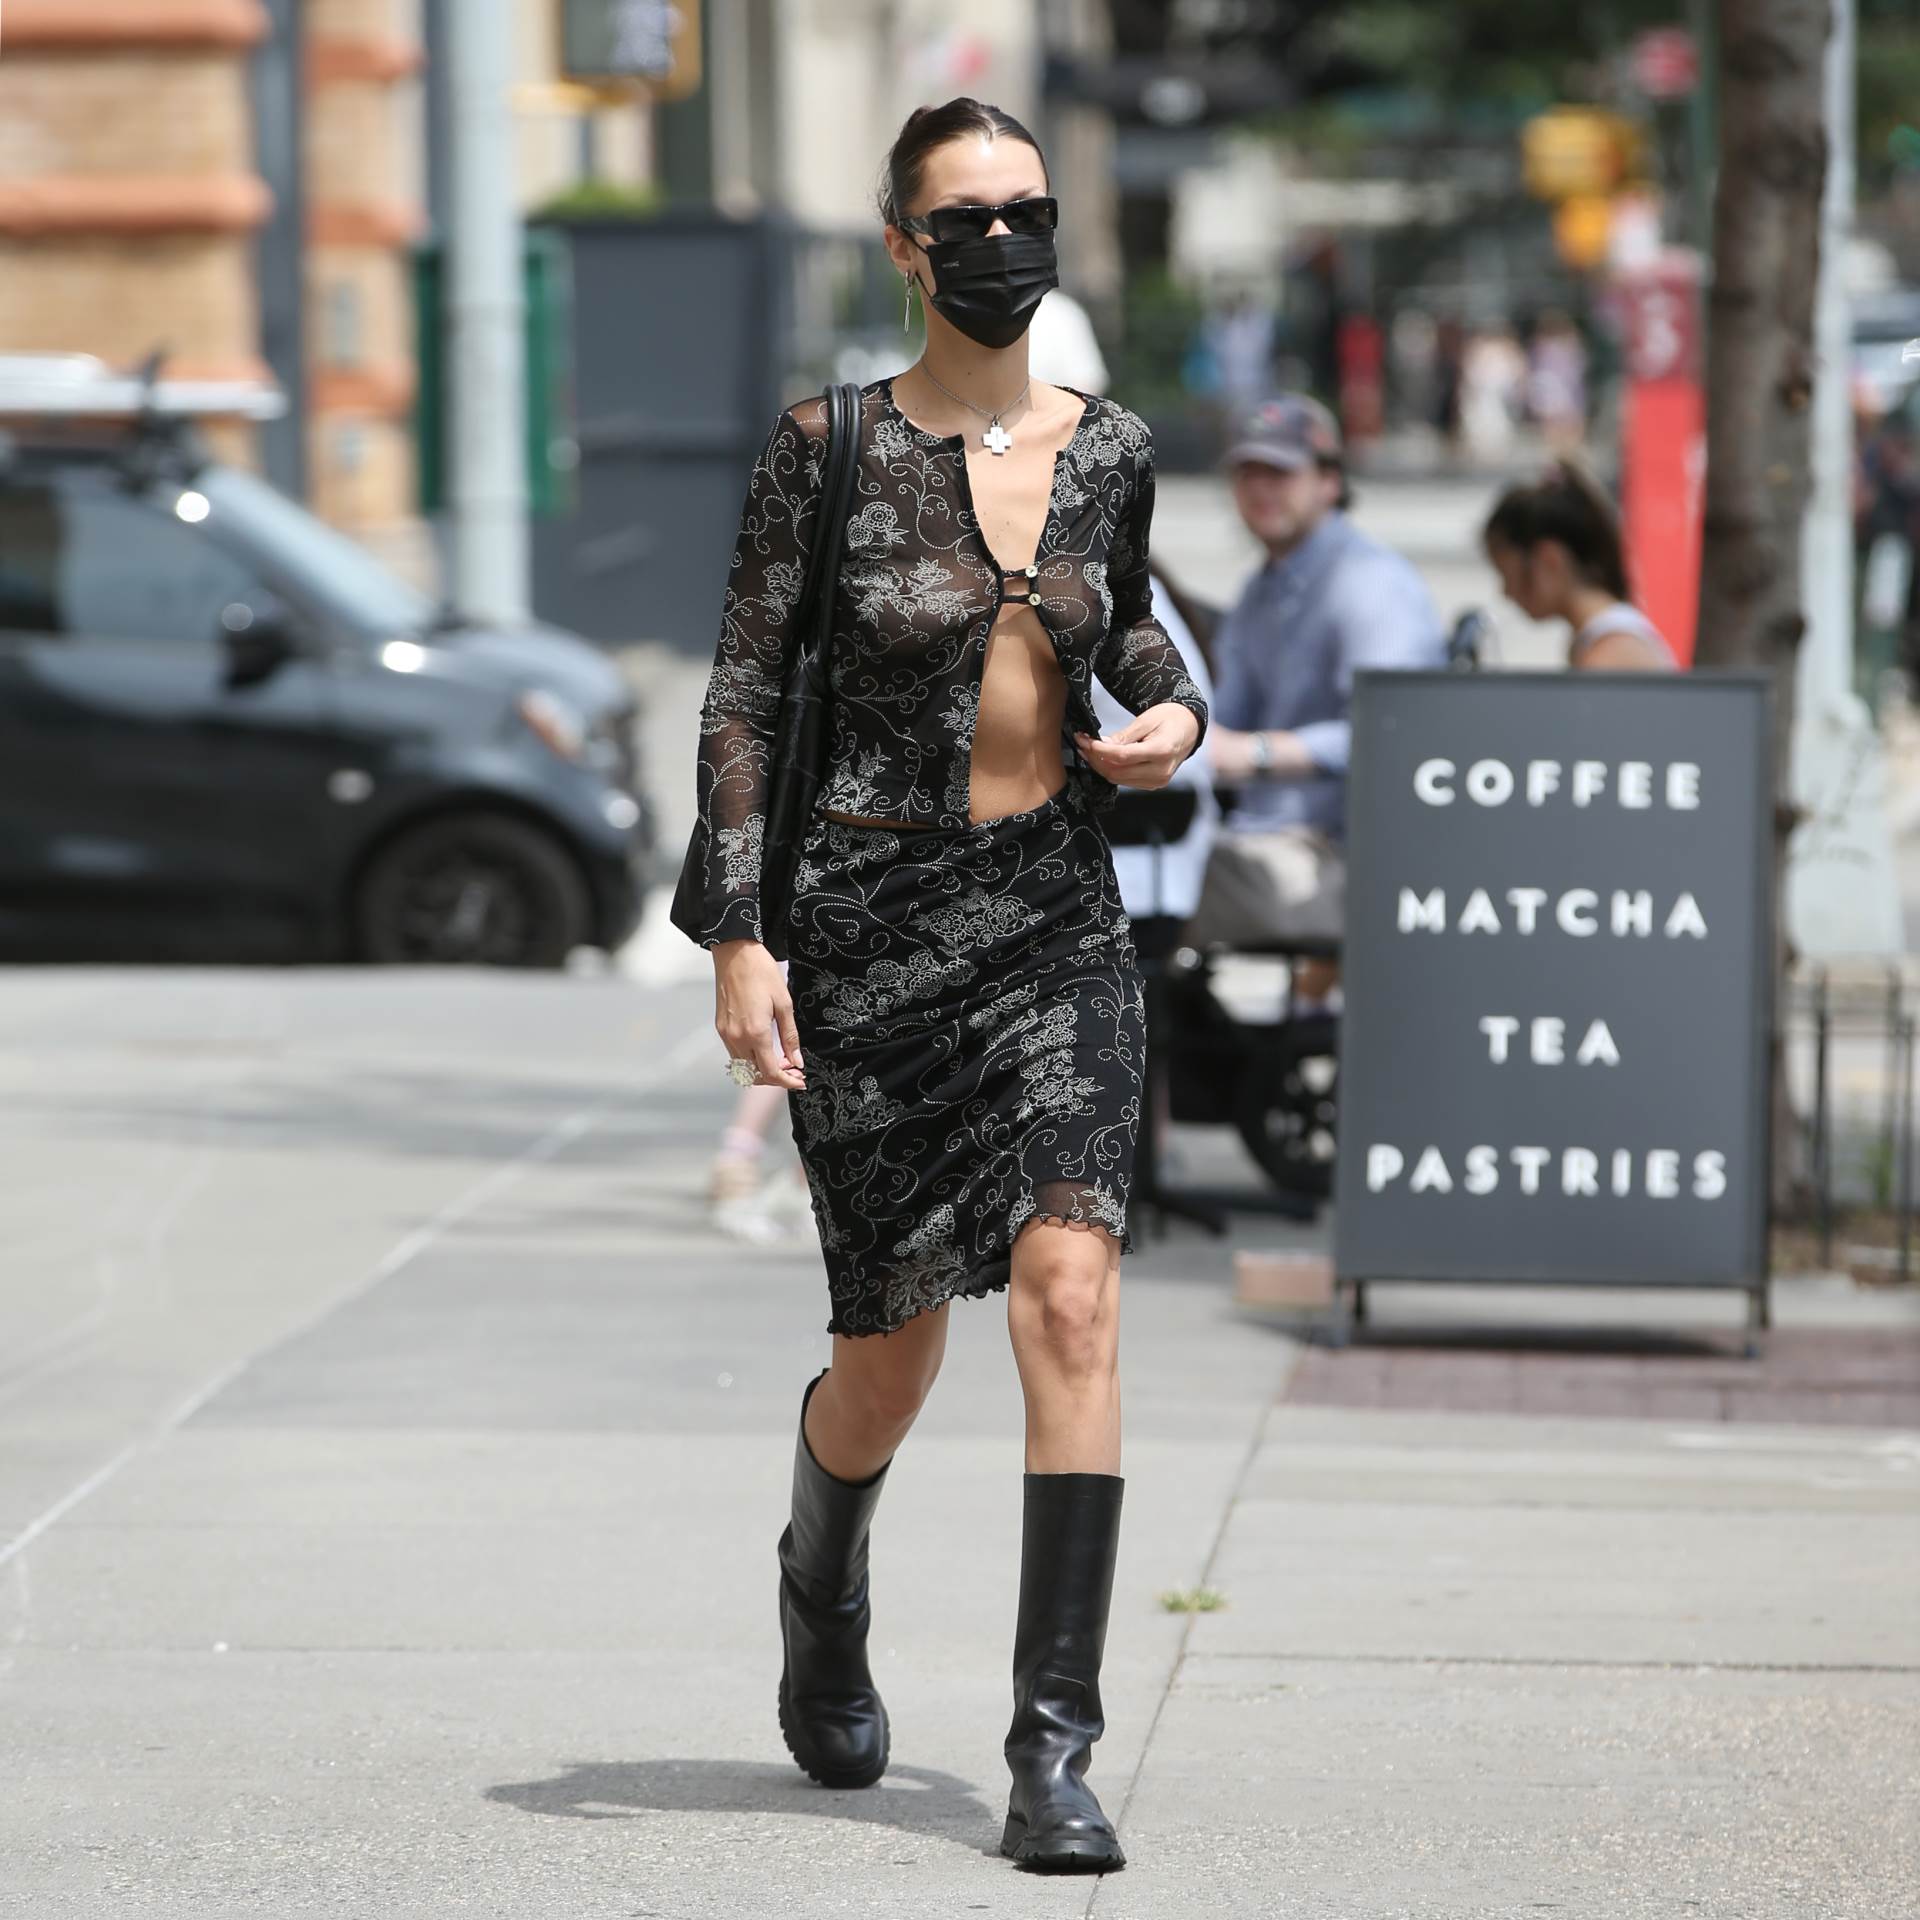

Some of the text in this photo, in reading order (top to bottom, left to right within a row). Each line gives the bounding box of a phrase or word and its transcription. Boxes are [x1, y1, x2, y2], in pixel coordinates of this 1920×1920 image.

[1413, 757, 1702, 810] COFFEE
[1397, 887, 1708, 939] MATCHA
[1480, 1015, 1621, 1066] TEA
[1366, 1143, 1728, 1199] PASTRIES
